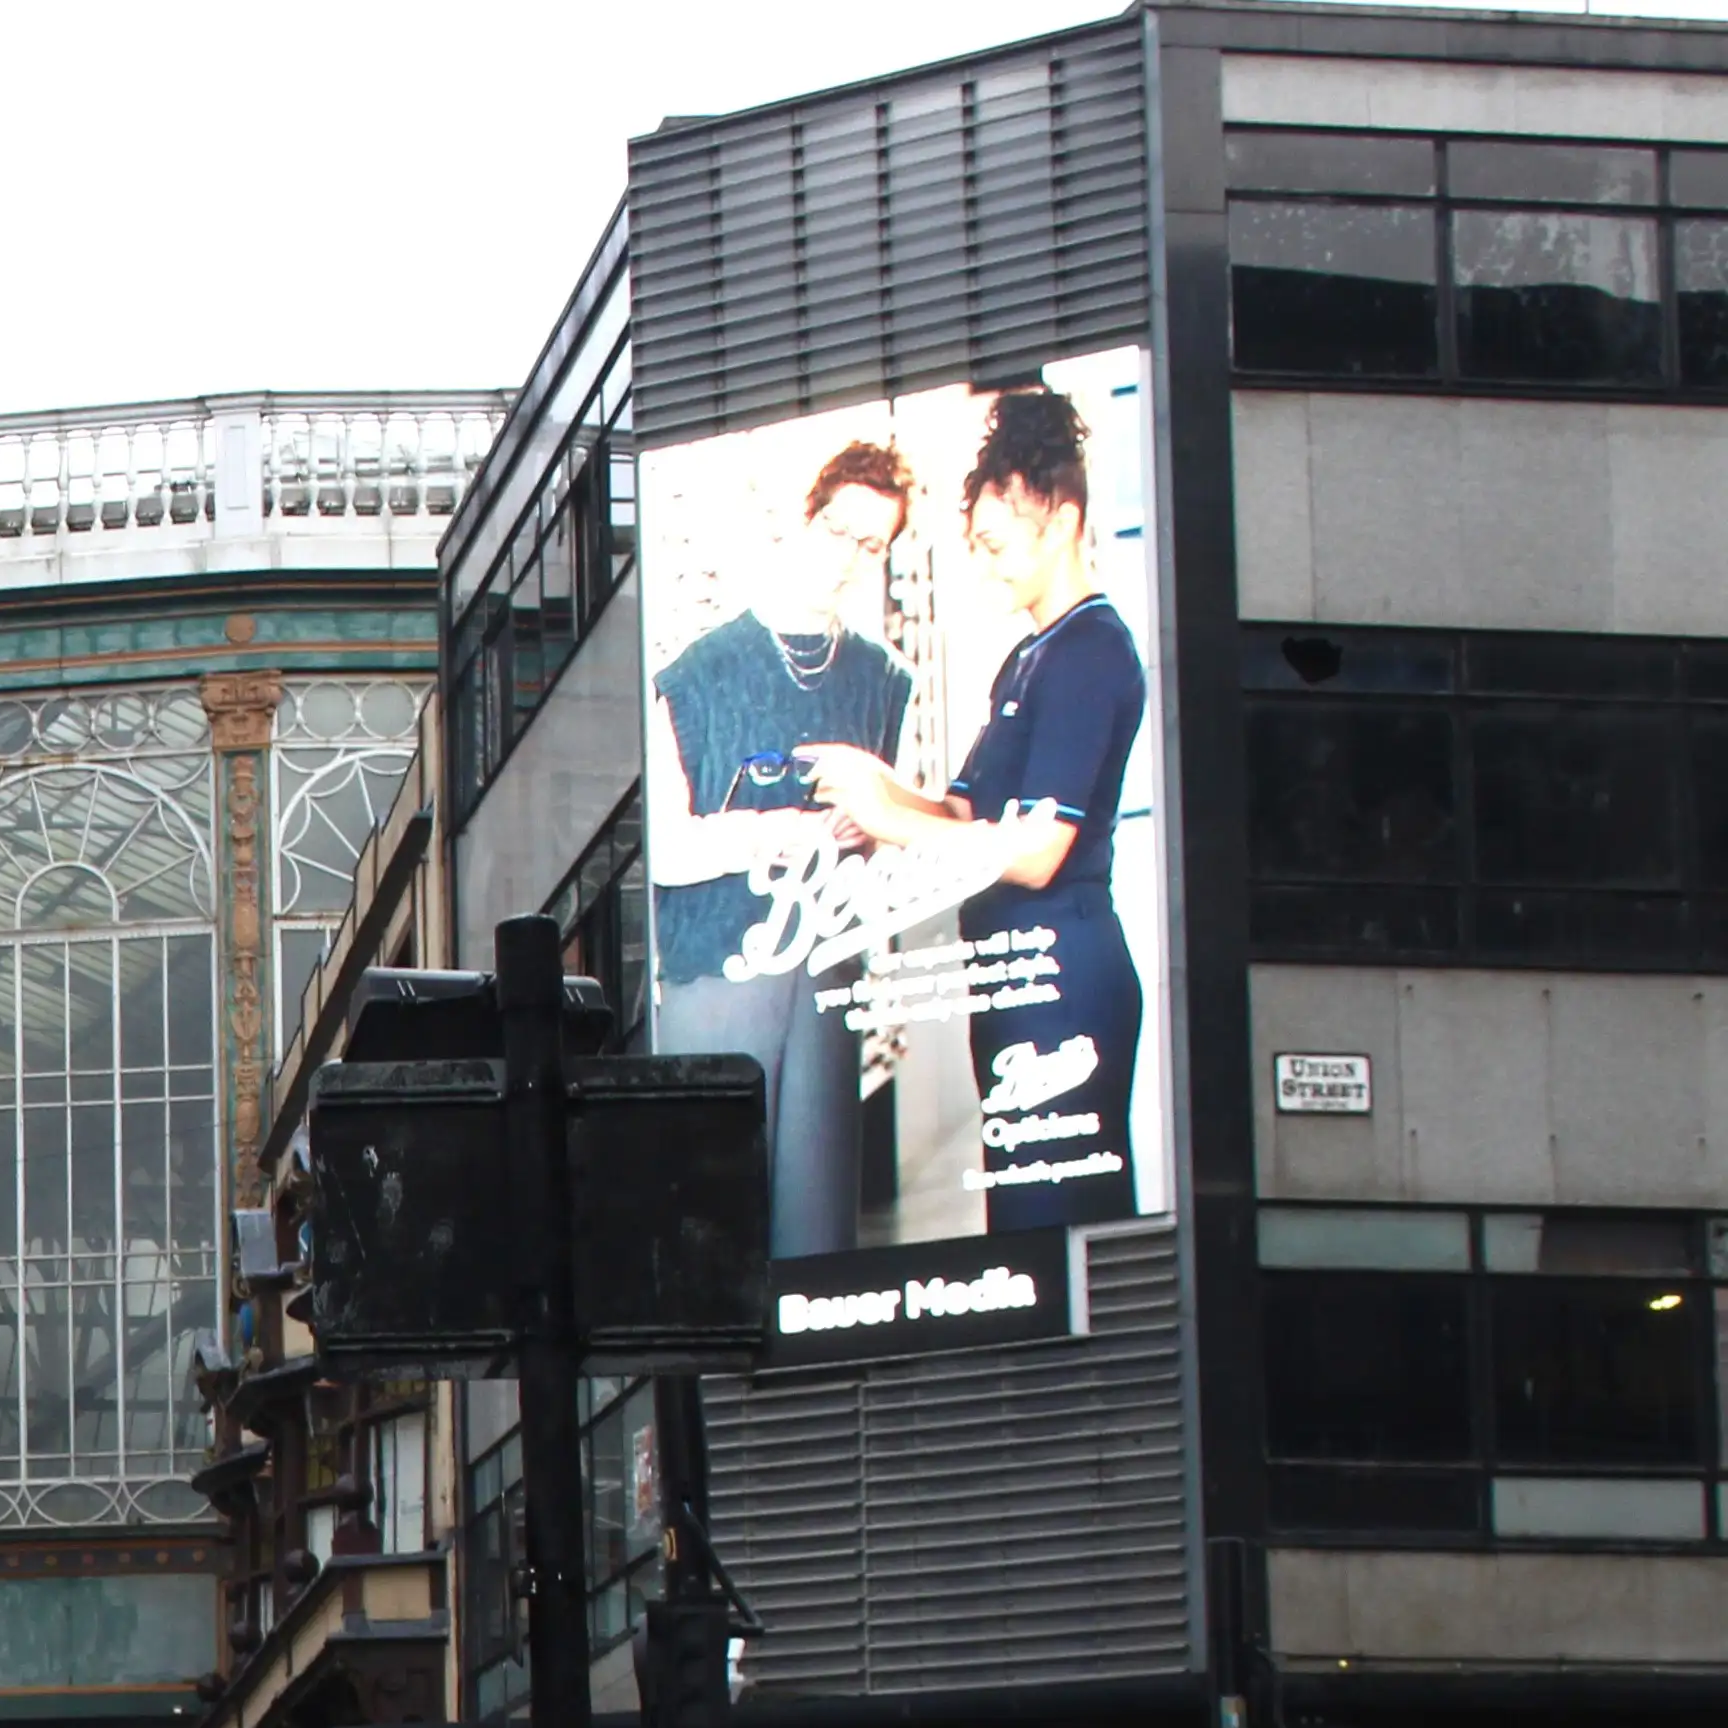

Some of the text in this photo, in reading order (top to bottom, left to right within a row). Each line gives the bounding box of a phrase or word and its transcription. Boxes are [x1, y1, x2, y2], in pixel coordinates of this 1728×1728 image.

[1290, 1058, 1355, 1077] UNION
[1282, 1079, 1366, 1098] STREET
[779, 1266, 1037, 1334] Bauer Media
